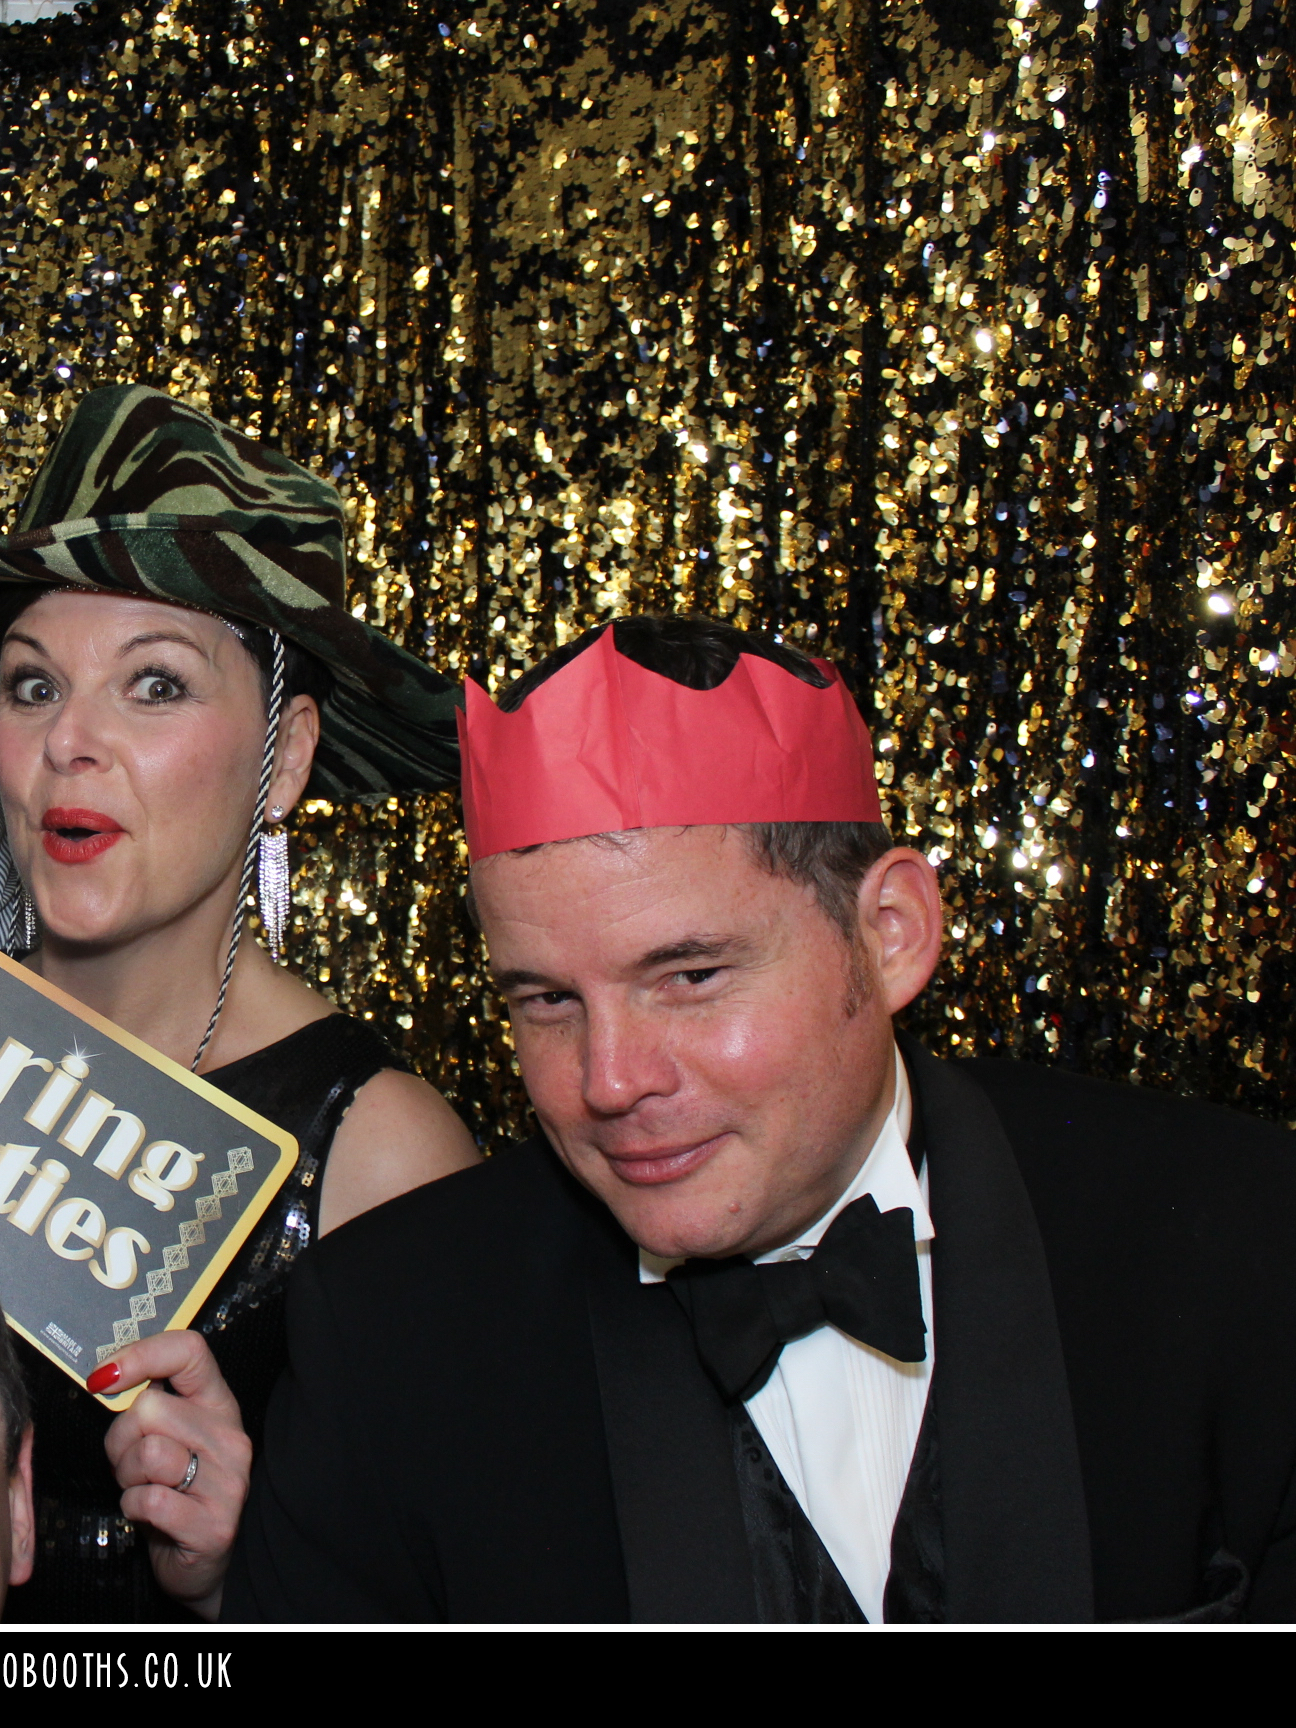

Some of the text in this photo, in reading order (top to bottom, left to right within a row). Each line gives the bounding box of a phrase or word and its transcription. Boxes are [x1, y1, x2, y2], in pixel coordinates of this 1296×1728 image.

[58, 1337, 79, 1357] BRITAIN
[61, 1332, 83, 1353] MADE IN
